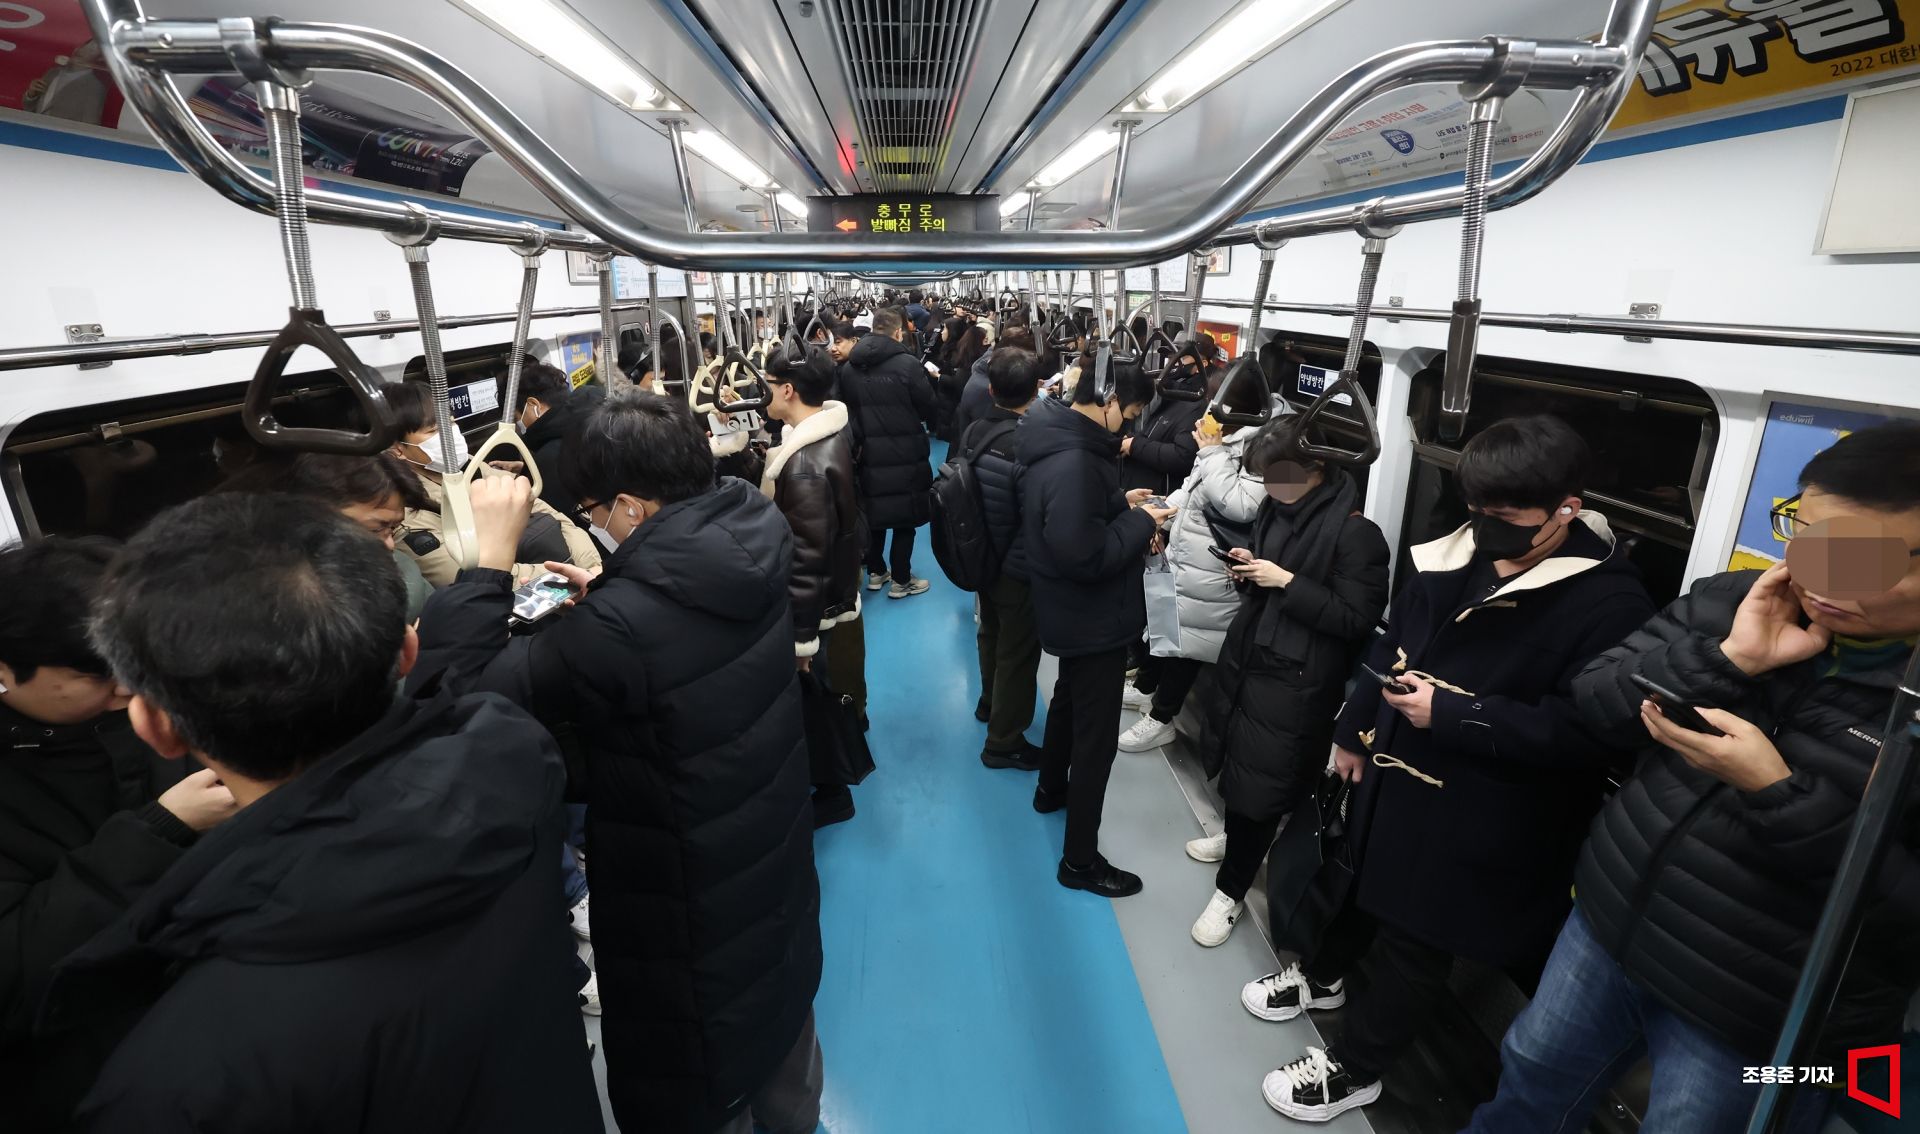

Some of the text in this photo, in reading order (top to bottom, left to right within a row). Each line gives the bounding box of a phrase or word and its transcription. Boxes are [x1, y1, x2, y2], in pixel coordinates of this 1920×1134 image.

[1638, 0, 1901, 95] 듀윌
[1831, 44, 1920, 77] 2022 대한
[871, 218, 945, 232] 발빠짐 주의
[1300, 373, 1323, 388] 약냉방칸
[1779, 414, 1815, 425] eduwill
